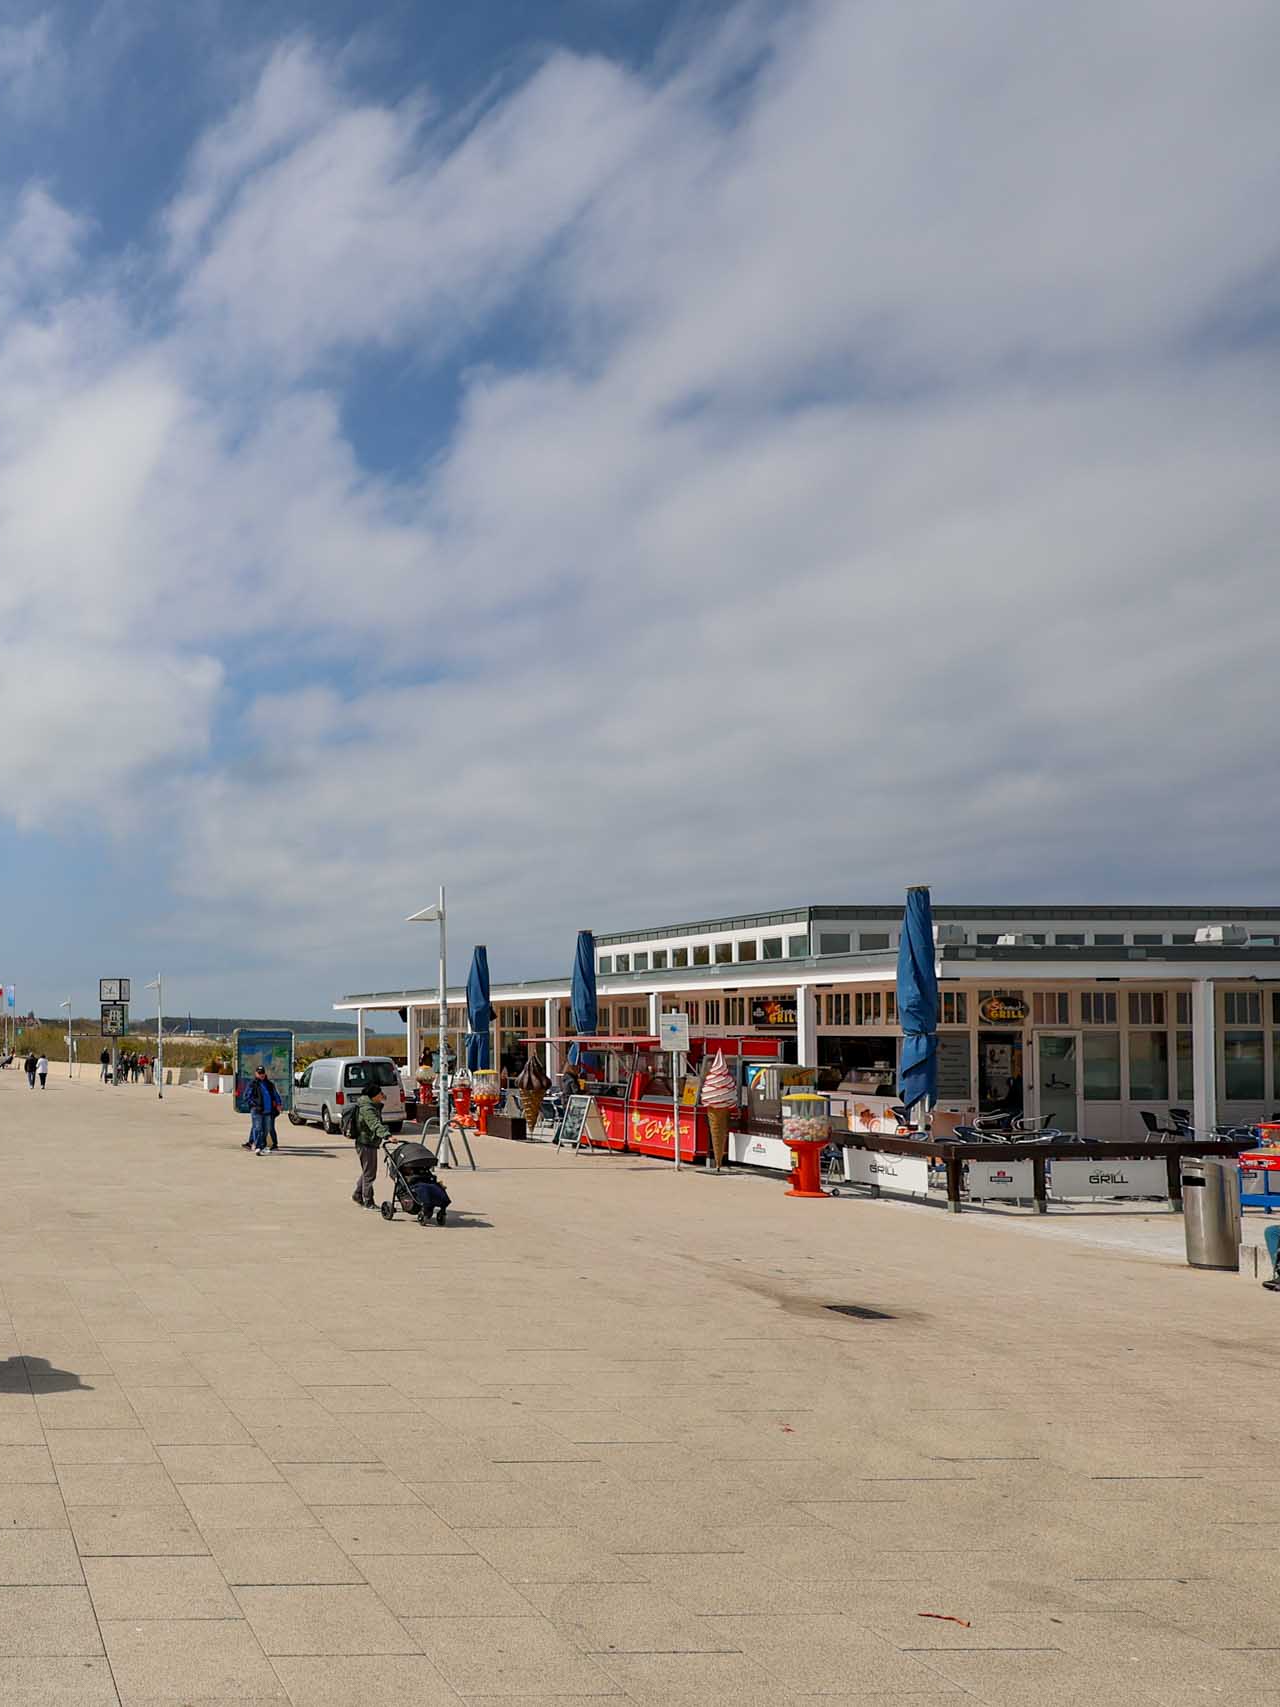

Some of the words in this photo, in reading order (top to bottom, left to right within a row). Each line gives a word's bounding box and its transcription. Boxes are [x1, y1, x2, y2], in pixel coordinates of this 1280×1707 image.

[769, 1013, 797, 1024] GRIL
[991, 1010, 1025, 1019] GRILL
[869, 1163, 898, 1177] GRILL
[1089, 1175, 1129, 1184] GRILL
